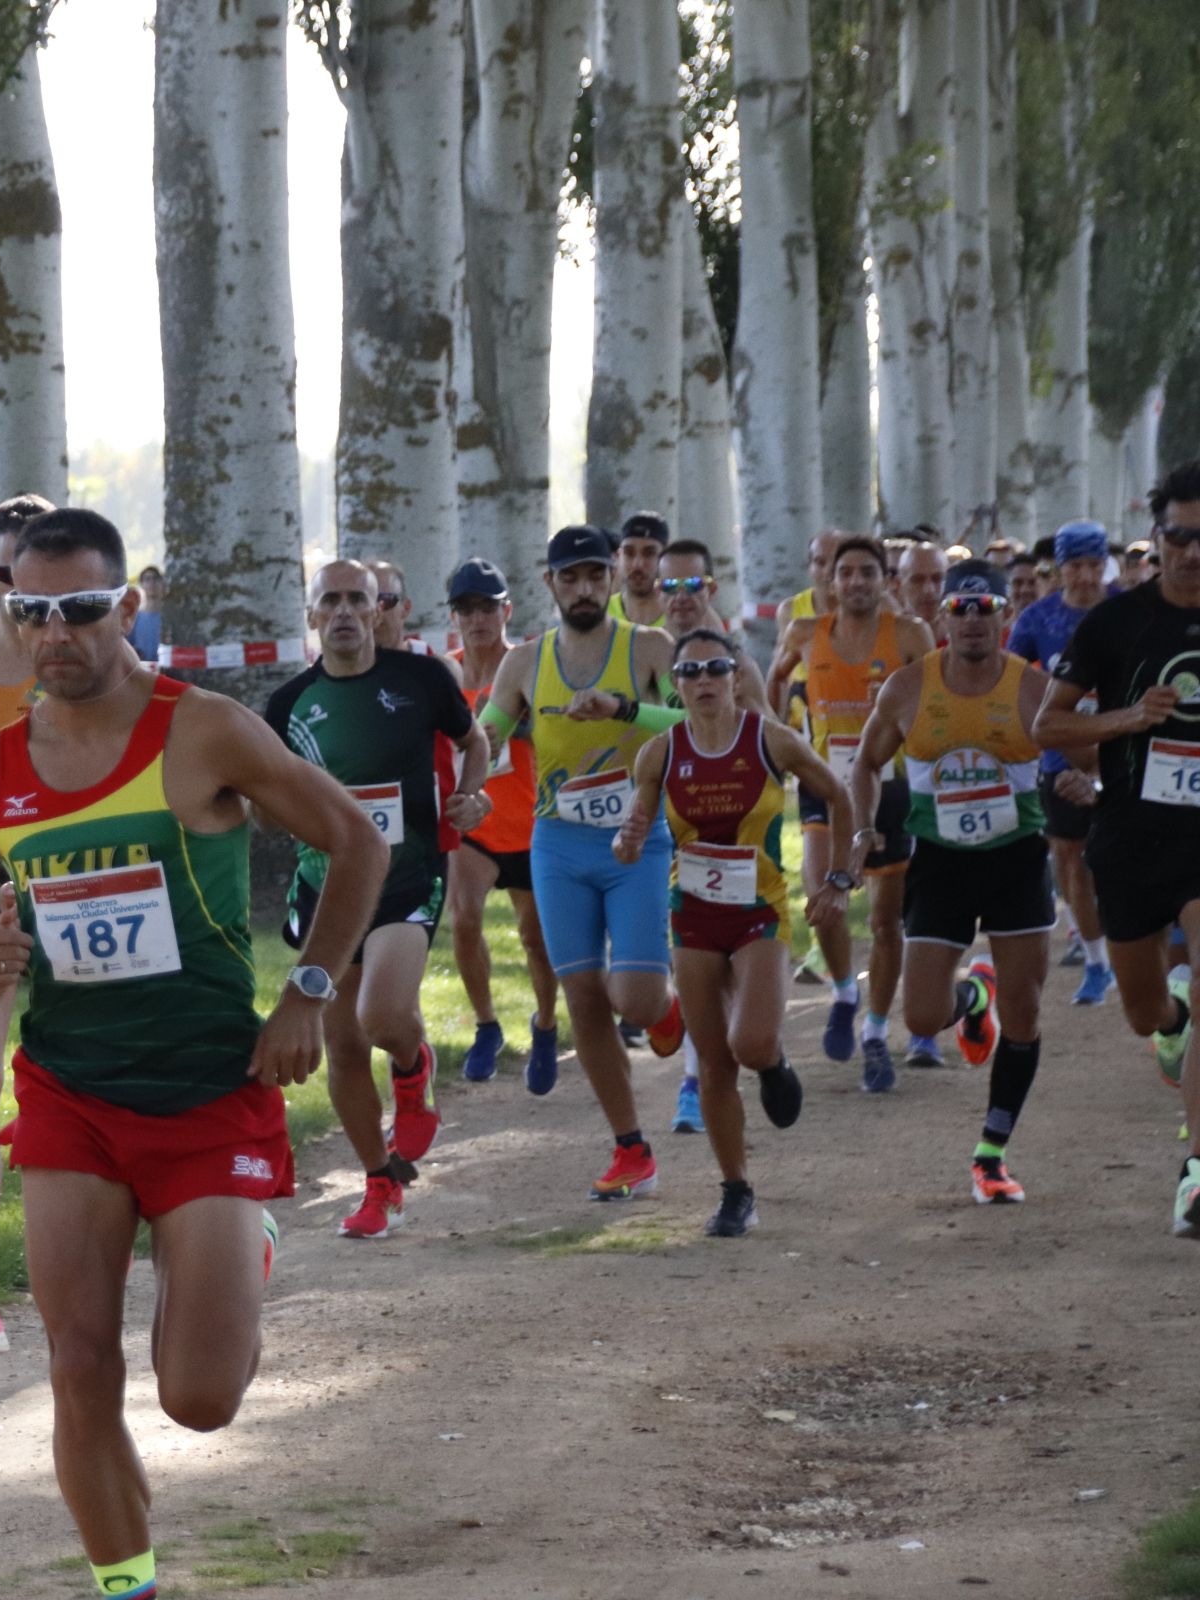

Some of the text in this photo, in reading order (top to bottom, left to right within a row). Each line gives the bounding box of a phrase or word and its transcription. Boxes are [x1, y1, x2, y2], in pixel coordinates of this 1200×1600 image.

[573, 794, 622, 820] 150
[960, 811, 991, 833] 61
[706, 869, 722, 891] 2
[81, 908, 108, 919] Ciudad
[110, 900, 159, 914] Universitaria
[89, 899, 118, 909] Carrera
[60, 913, 145, 961] 187
